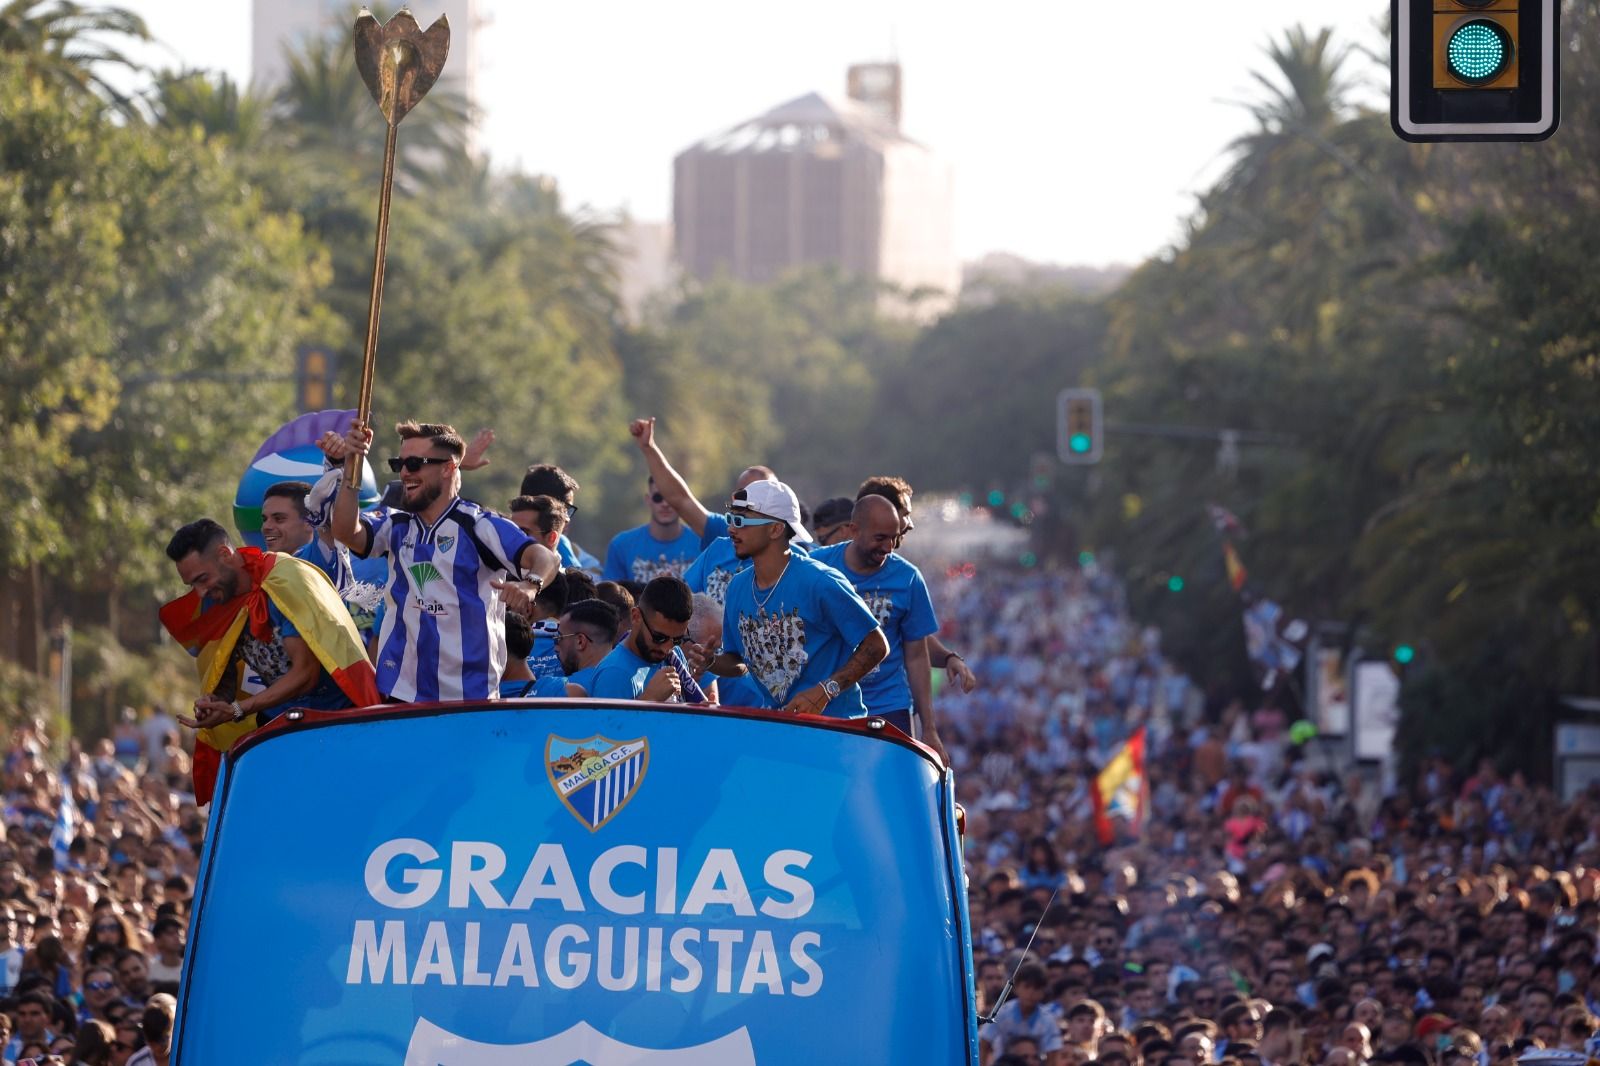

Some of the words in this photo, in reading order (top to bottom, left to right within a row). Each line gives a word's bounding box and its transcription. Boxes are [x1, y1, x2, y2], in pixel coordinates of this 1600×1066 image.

[610, 745, 632, 761] C.F.
[364, 838, 816, 920] GRACIAS
[346, 920, 824, 997] MALAGUISTAS
